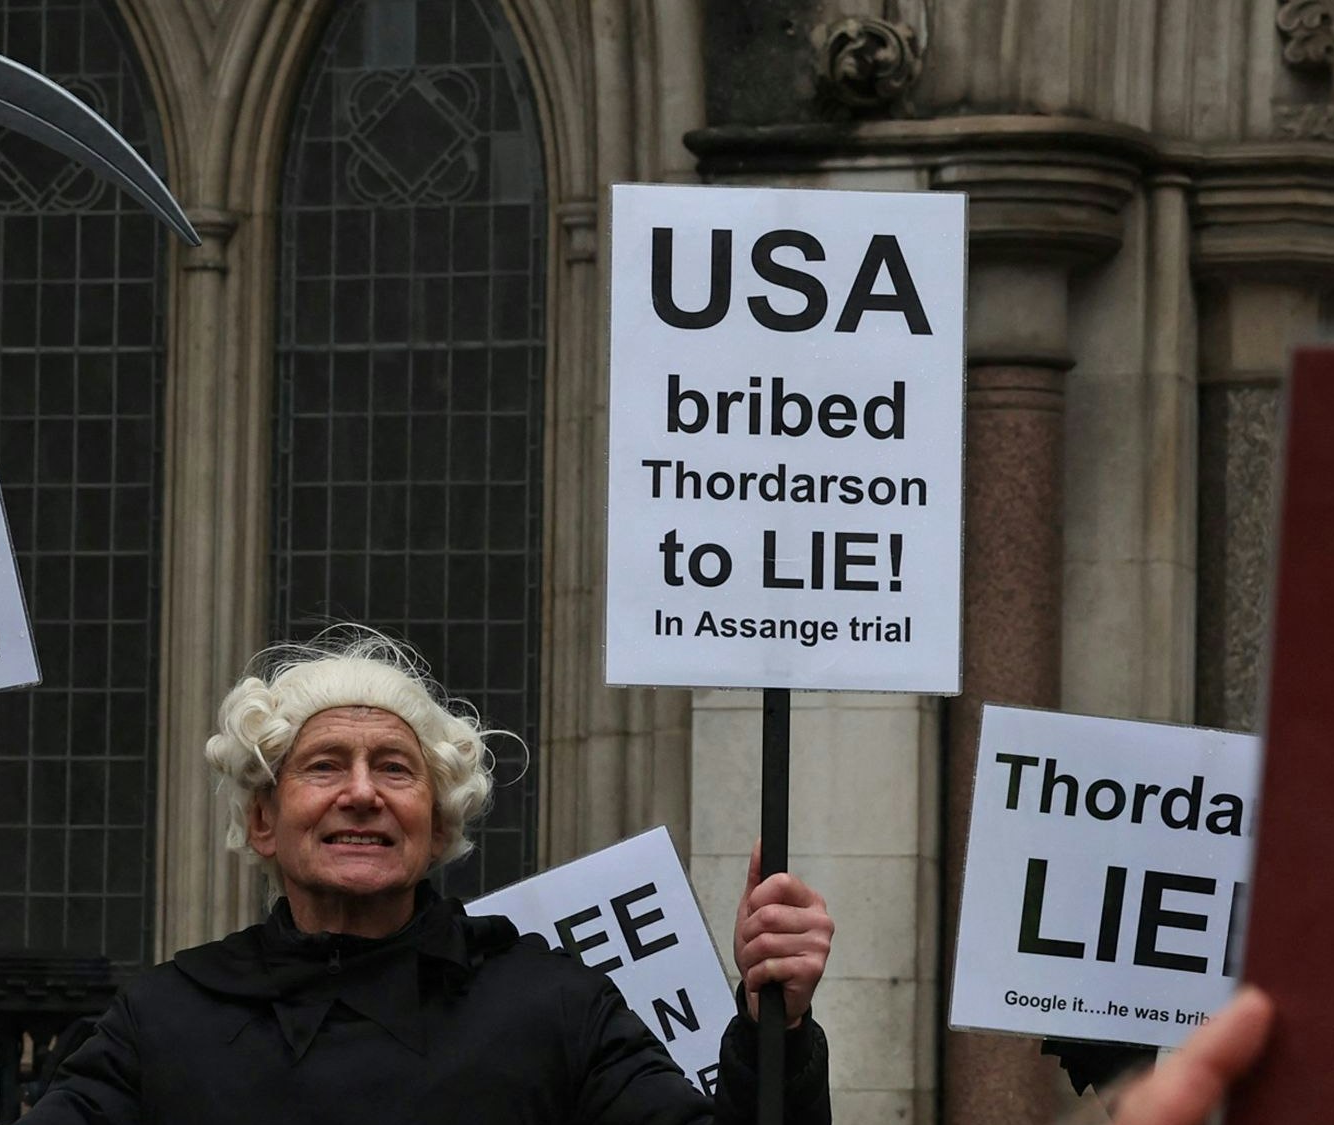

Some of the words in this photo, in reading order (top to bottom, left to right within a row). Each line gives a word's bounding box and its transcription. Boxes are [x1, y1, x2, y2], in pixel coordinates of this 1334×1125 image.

[651, 227, 933, 335] USA
[667, 374, 906, 439] bribed
[641, 459, 928, 506] Thordarson
[659, 528, 733, 587] to
[762, 530, 904, 592] LIE!
[655, 610, 684, 637] In
[694, 610, 839, 647] Assange
[849, 615, 912, 643] trial
[996, 752, 1253, 837] Thorda
[1004, 990, 1067, 1012] Google
[1135, 1007, 1170, 1022] was
